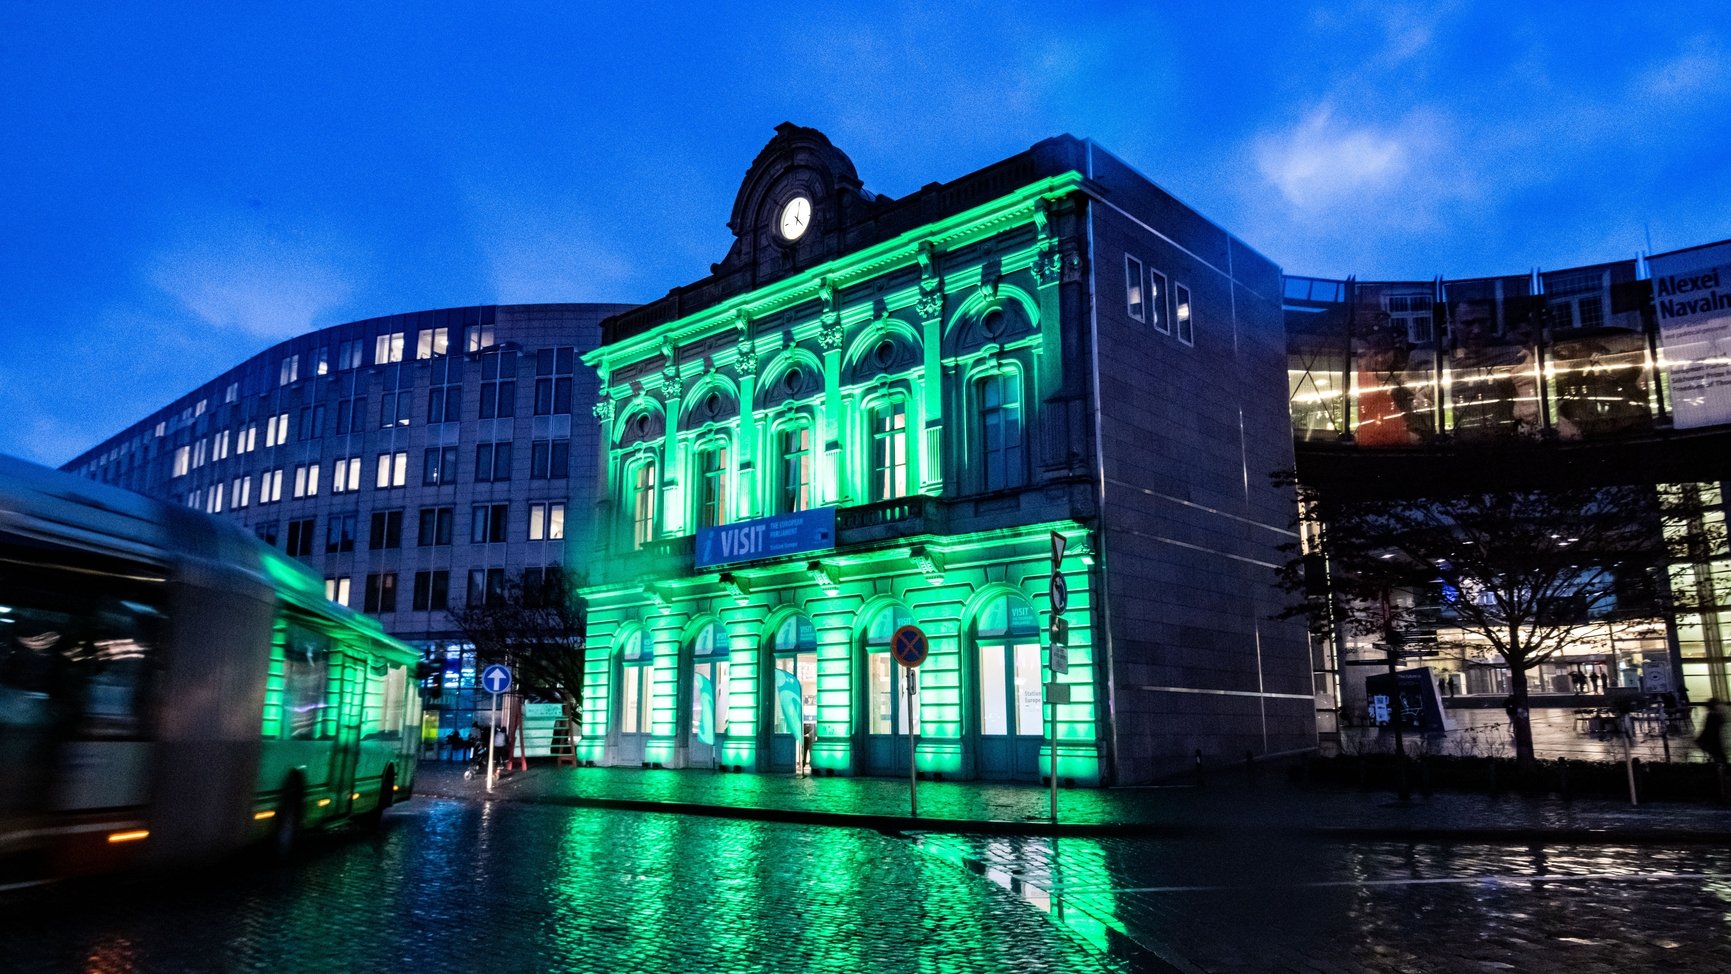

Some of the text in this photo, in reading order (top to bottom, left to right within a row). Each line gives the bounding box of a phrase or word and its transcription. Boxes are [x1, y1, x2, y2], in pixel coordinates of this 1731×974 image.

[1658, 268, 1720, 297] Alexei
[721, 524, 766, 558] VISIT
[1011, 607, 1028, 617] VISIT
